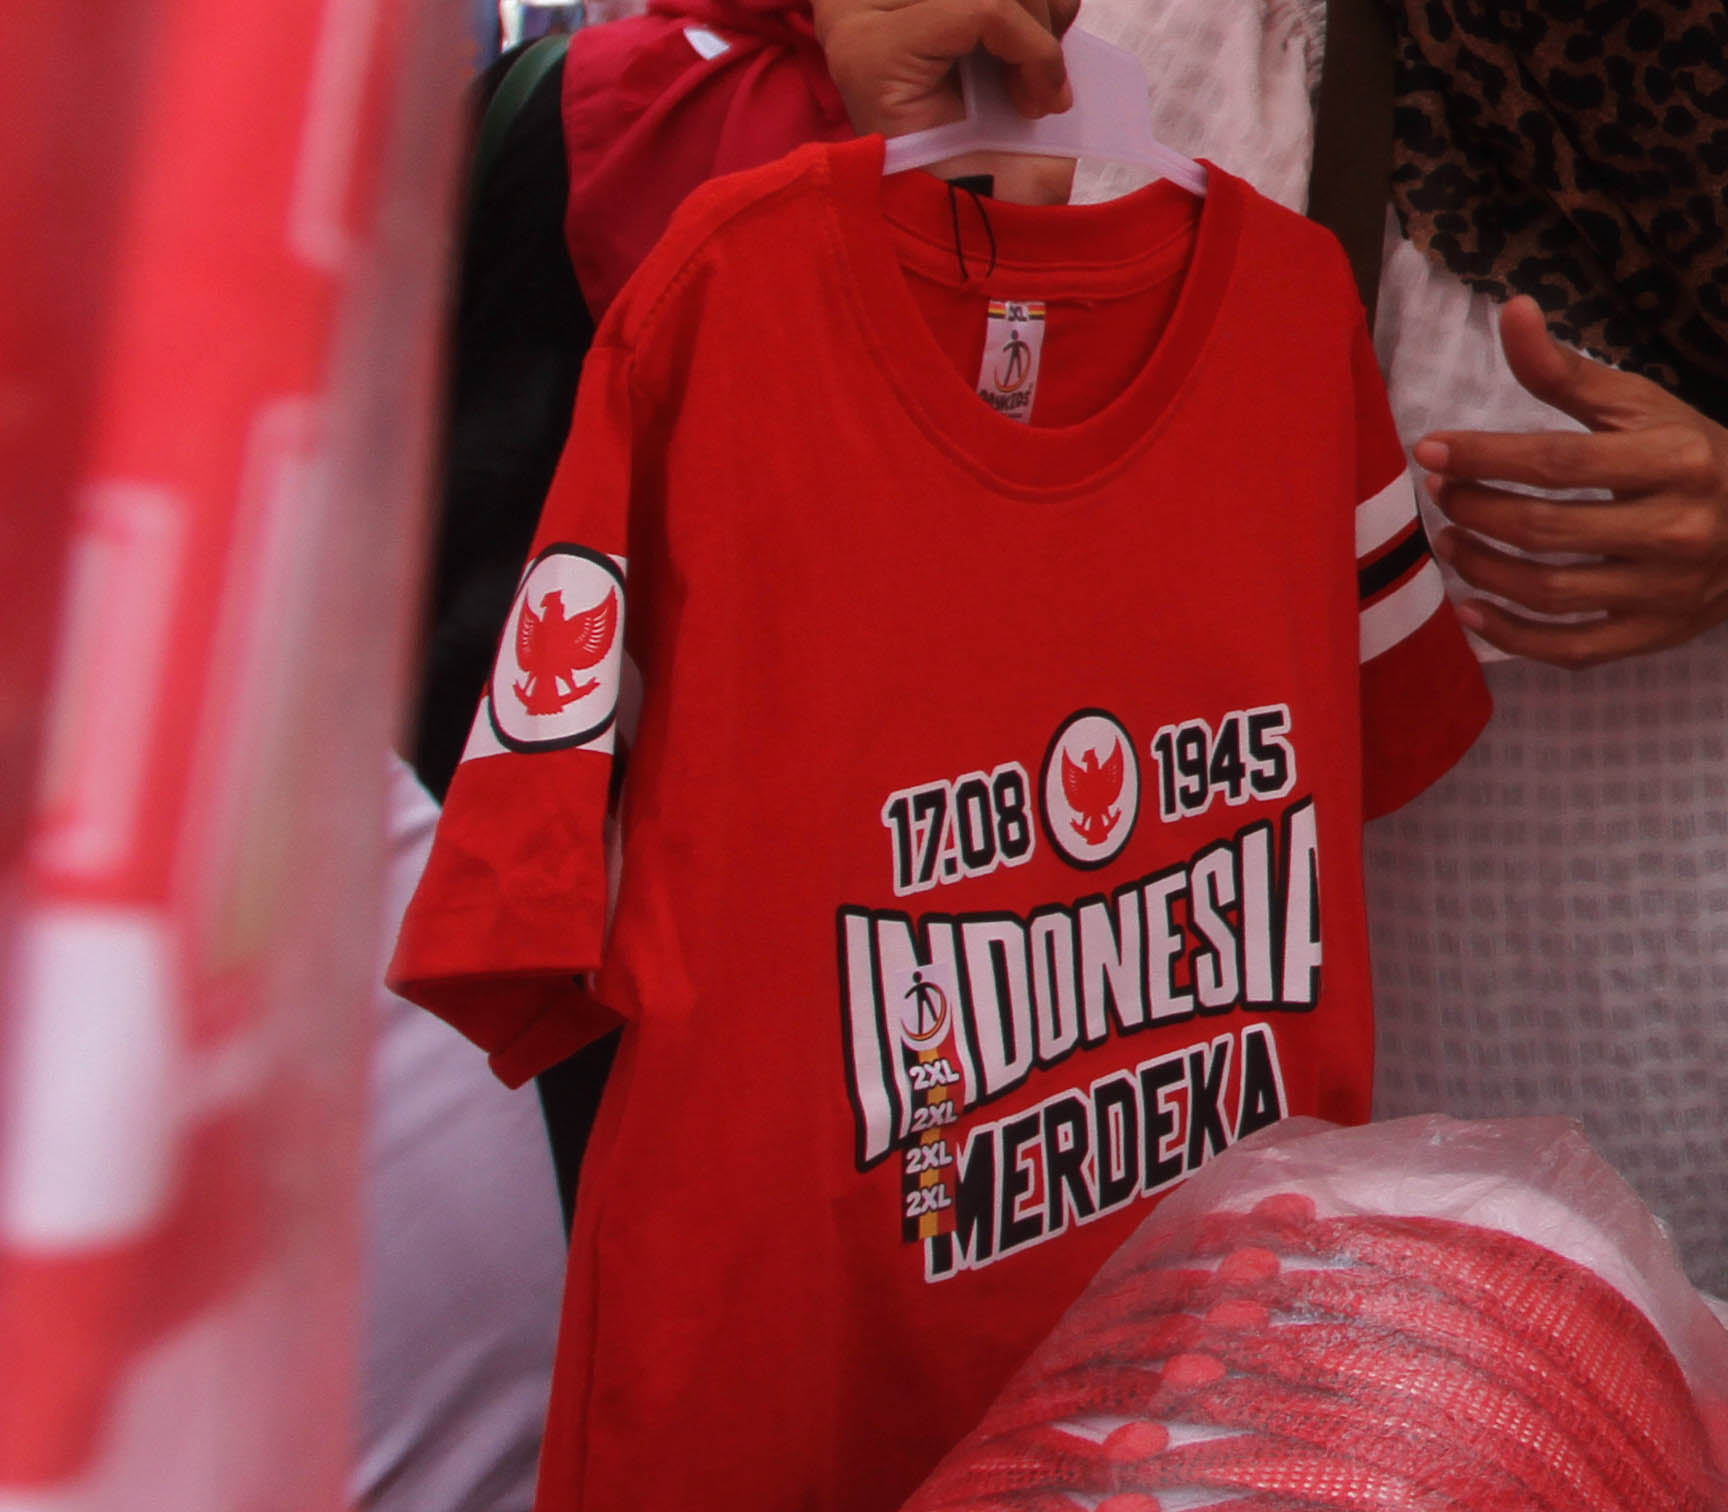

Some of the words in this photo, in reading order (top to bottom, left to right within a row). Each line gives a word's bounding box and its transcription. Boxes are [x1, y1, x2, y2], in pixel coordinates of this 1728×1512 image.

[883, 762, 1034, 895] 17.08
[1152, 705, 1295, 821] 1945
[838, 795, 1322, 1173] INDONESIA
[909, 1059, 960, 1090] 2XL
[910, 1101, 958, 1133] 2XL
[905, 1141, 953, 1174] 2XL
[923, 1023, 1289, 1283] MERDEKA
[905, 1184, 952, 1217] 2XL
